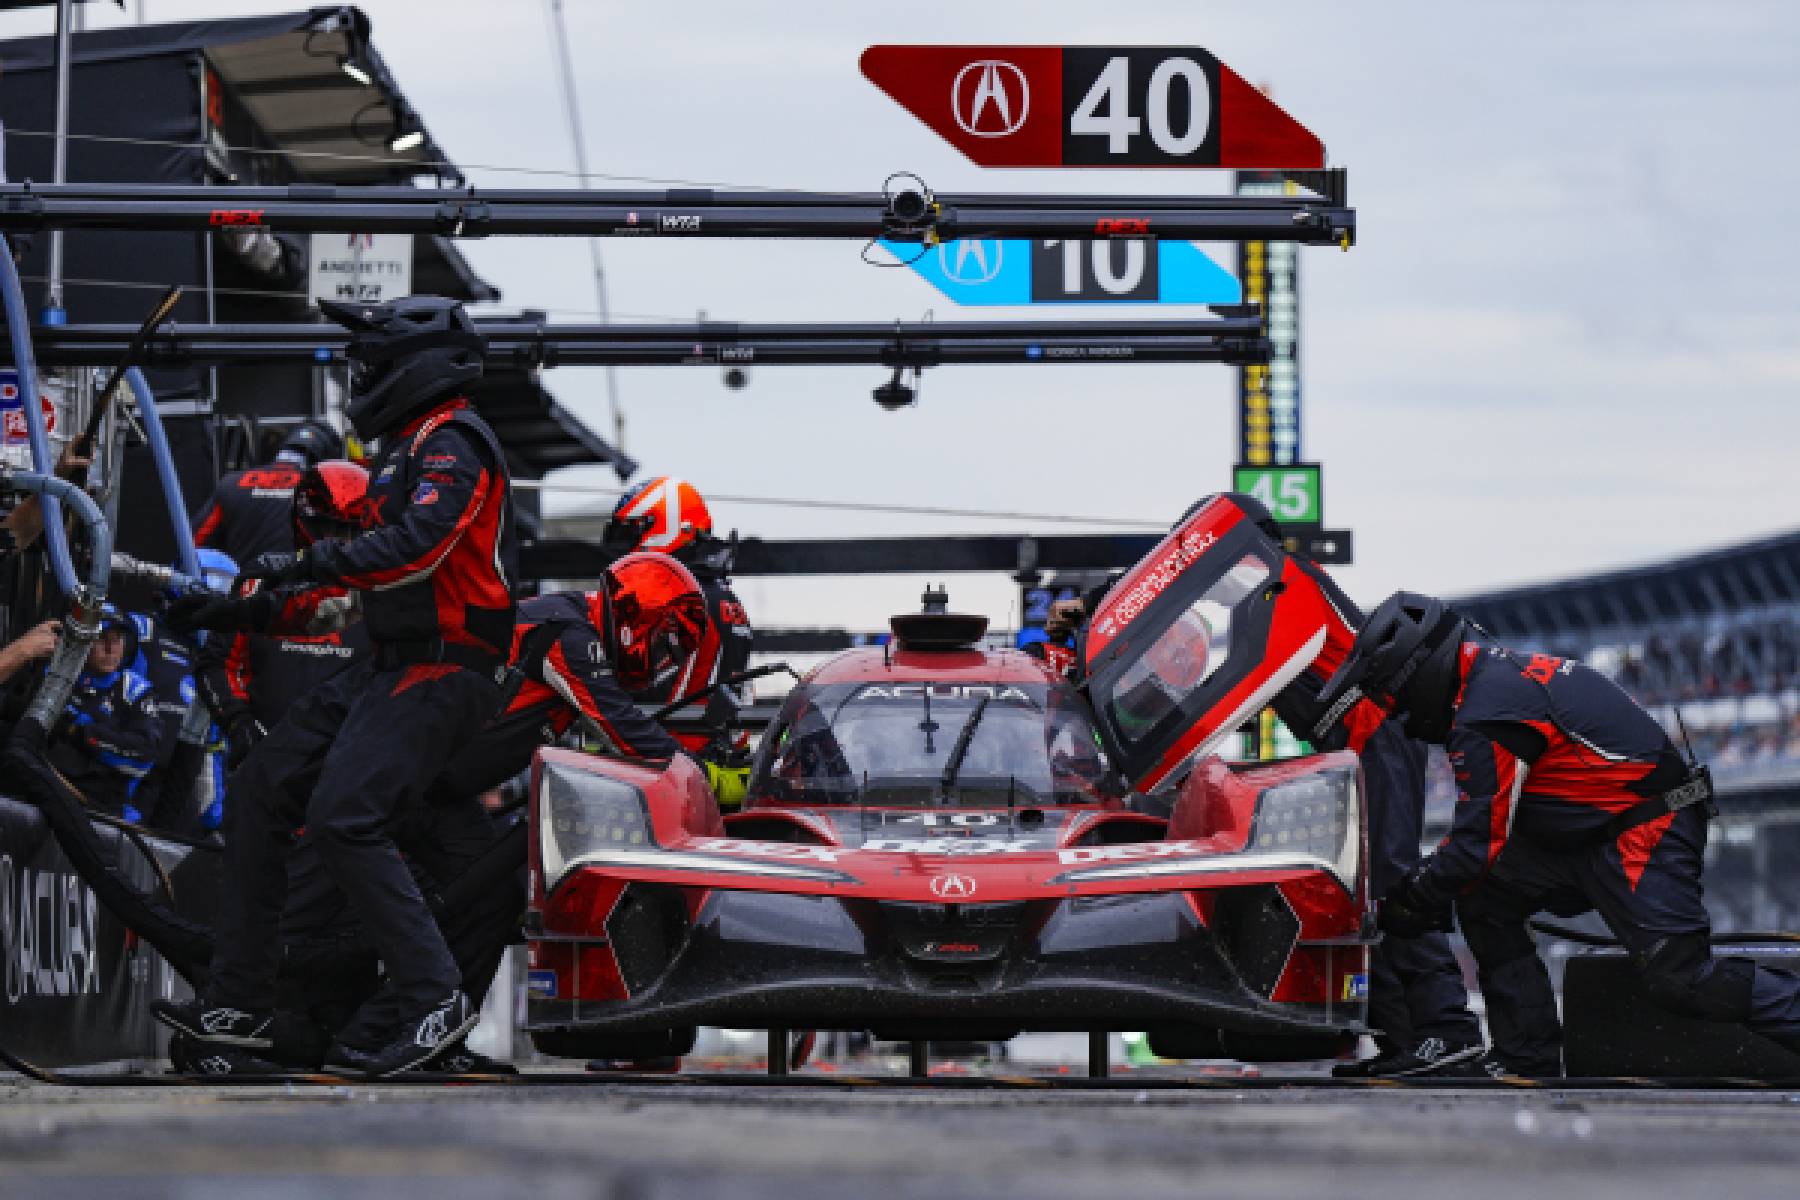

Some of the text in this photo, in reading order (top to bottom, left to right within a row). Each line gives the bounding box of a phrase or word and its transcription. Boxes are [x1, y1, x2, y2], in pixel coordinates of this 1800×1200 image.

[1071, 57, 1211, 156] 40
[209, 209, 266, 225] DEX
[1094, 217, 1151, 235] DEX
[1043, 240, 1146, 294] 10
[1249, 471, 1308, 518] 45
[857, 687, 1030, 700] ACURA
[860, 839, 1041, 855] DEX
[1058, 842, 1200, 864] DEX
[20, 868, 101, 995] ACURA
